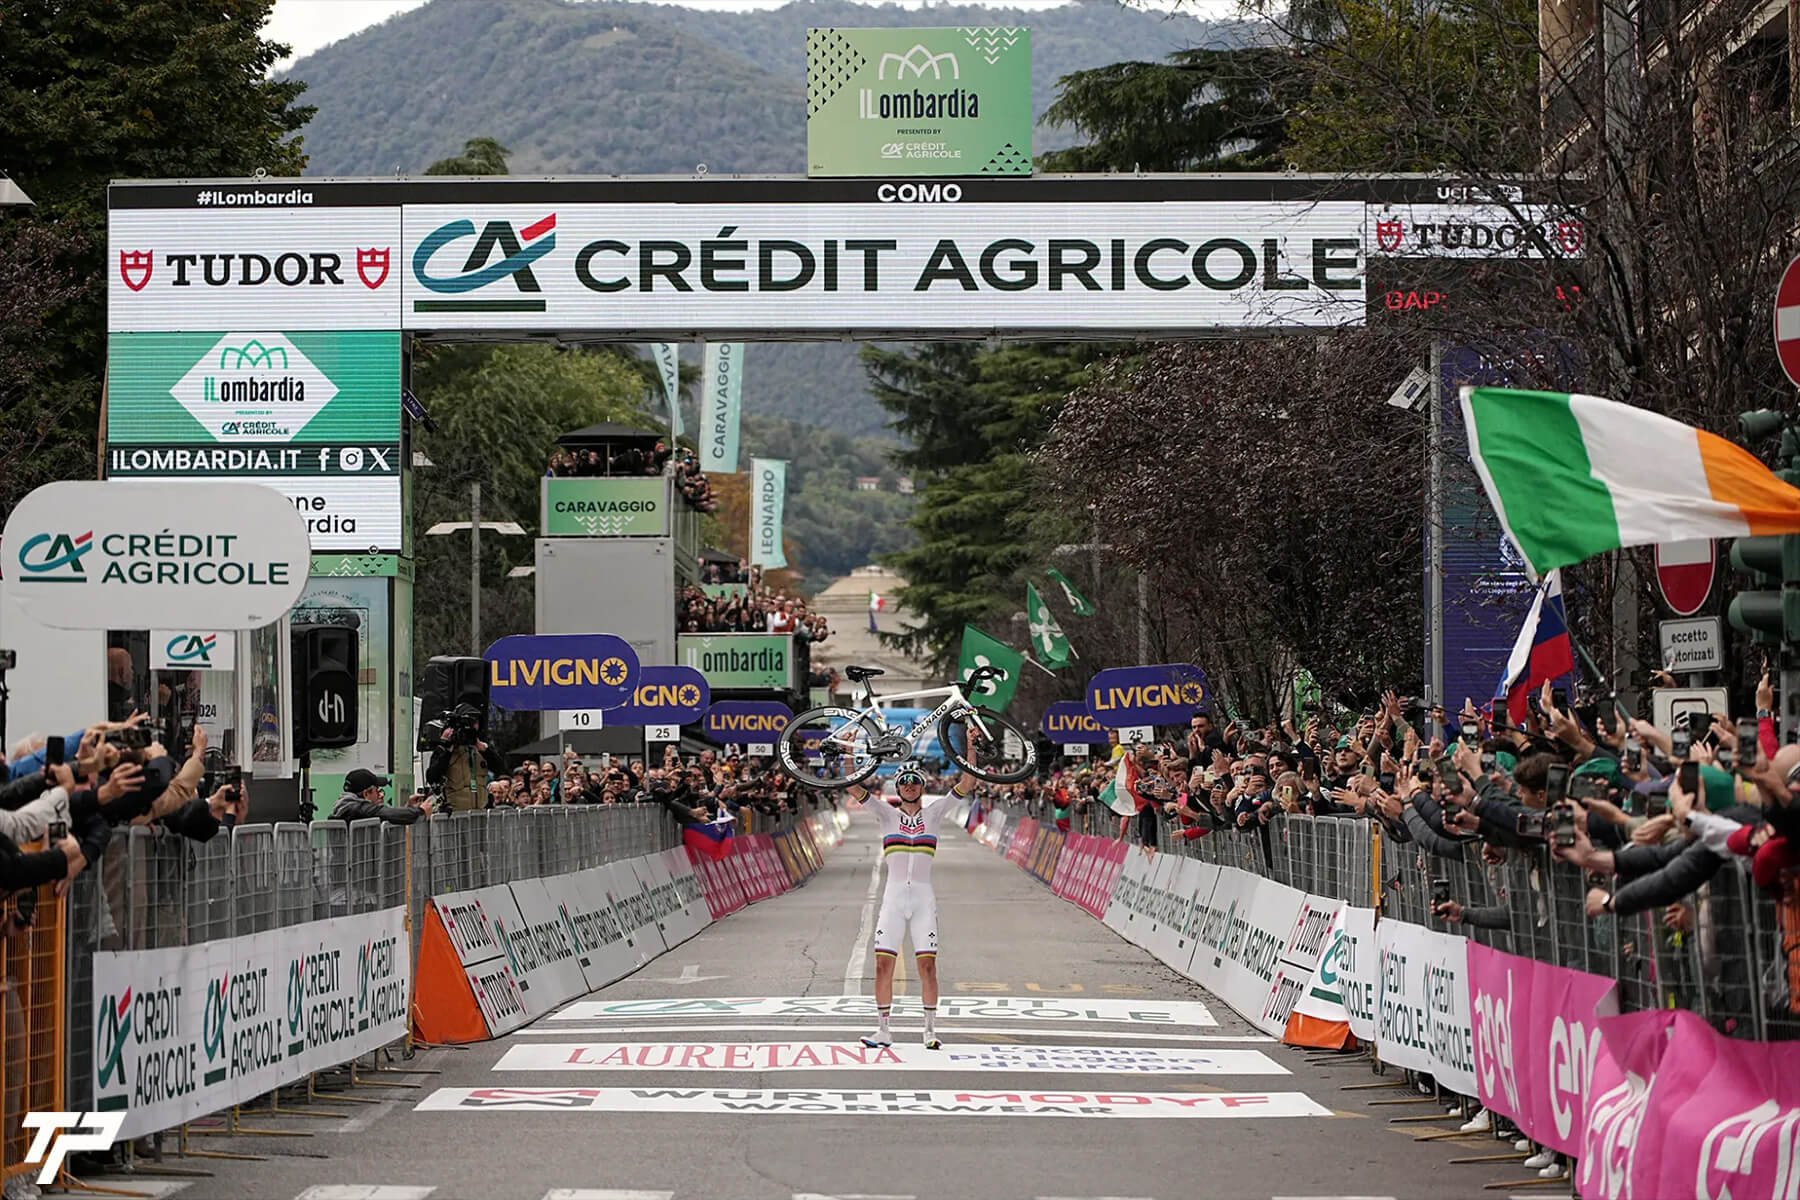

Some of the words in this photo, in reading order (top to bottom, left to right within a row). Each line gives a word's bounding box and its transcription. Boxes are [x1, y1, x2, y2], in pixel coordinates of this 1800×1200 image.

[859, 88, 979, 119] ILombardia
[905, 141, 946, 151] CRÉDIT
[905, 150, 961, 158] AGRICOLE
[197, 190, 313, 205] #ILombardia
[877, 183, 962, 202] COMO
[166, 252, 344, 286] TUDOR
[574, 226, 898, 293] CRÉDIT
[913, 237, 1362, 292] AGRICOLE
[204, 376, 305, 401] ILombardia
[712, 343, 732, 459] CARAVAGGIO
[242, 421, 276, 429] CRÉDIT
[112, 449, 302, 471] ILOMBARDIA.IT
[555, 501, 656, 513] CARAVAGGIO
[760, 469, 775, 555] LEONARDO
[102, 527, 237, 558] CRÉDIT
[101, 560, 290, 585] AGRICOLE
[1671, 629, 1708, 644] eccetto
[1675, 647, 1715, 663] torizzati
[491, 657, 629, 686] LIVIGNO
[623, 684, 701, 707] IGNO
[1095, 682, 1203, 711] LIVIGNO
[200, 704, 217, 718] 024
[572, 713, 590, 726] 10
[710, 714, 790, 731] LIVIGNO
[911, 704, 948, 738] COLNAGO
[1049, 714, 1110, 732] LIVIG
[656, 728, 670, 738] 25
[1128, 730, 1144, 741] 25
[755, 745, 766, 753] 50
[1072, 745, 1082, 753] 50
[370, 930, 397, 981] CRÉDIT
[305, 942, 341, 999] CRÉDIT
[230, 960, 267, 1022] CRÉDIT
[370, 979, 405, 1028] AGRICOLE
[134, 976, 182, 1045] CRÉDIT
[305, 996, 355, 1049] AGRICOLE
[231, 1018, 282, 1079] AGRICOLE
[565, 1044, 905, 1069] LAURETANA
[134, 1043, 196, 1109] AGRICOLE
[1550, 1016, 1603, 1141] en
[720, 1102, 1112, 1115] WORKWEAR
[955, 1093, 1269, 1108] MODYF
